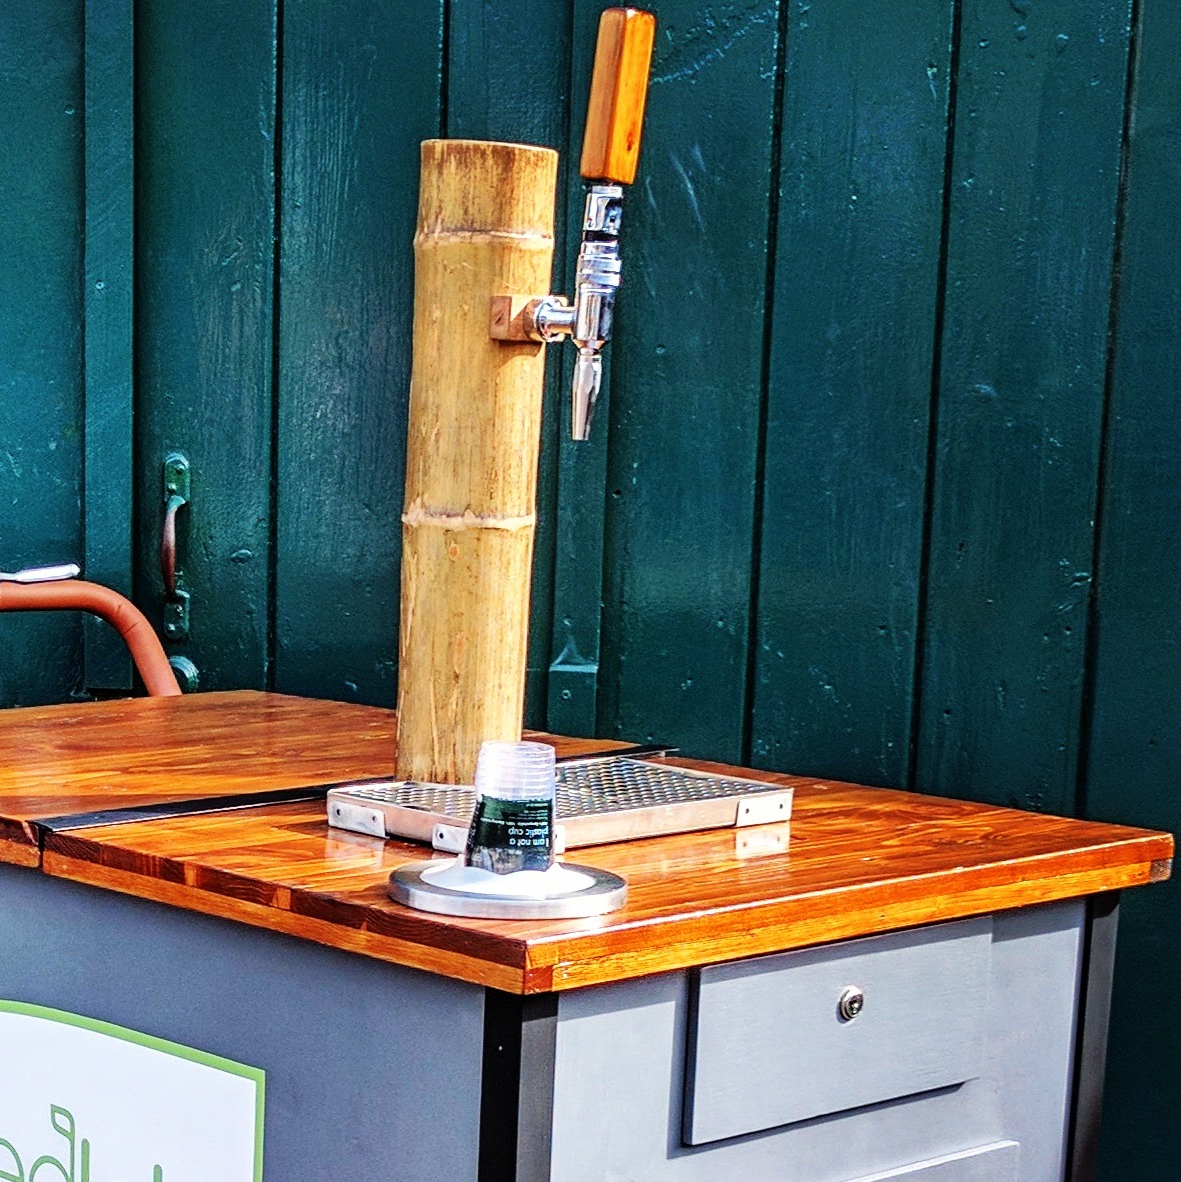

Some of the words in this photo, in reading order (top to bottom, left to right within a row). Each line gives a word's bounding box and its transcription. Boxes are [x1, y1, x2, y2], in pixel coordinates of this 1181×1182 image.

[508, 826, 524, 835] cup
[525, 825, 549, 838] plastic
[517, 839, 531, 847] not
